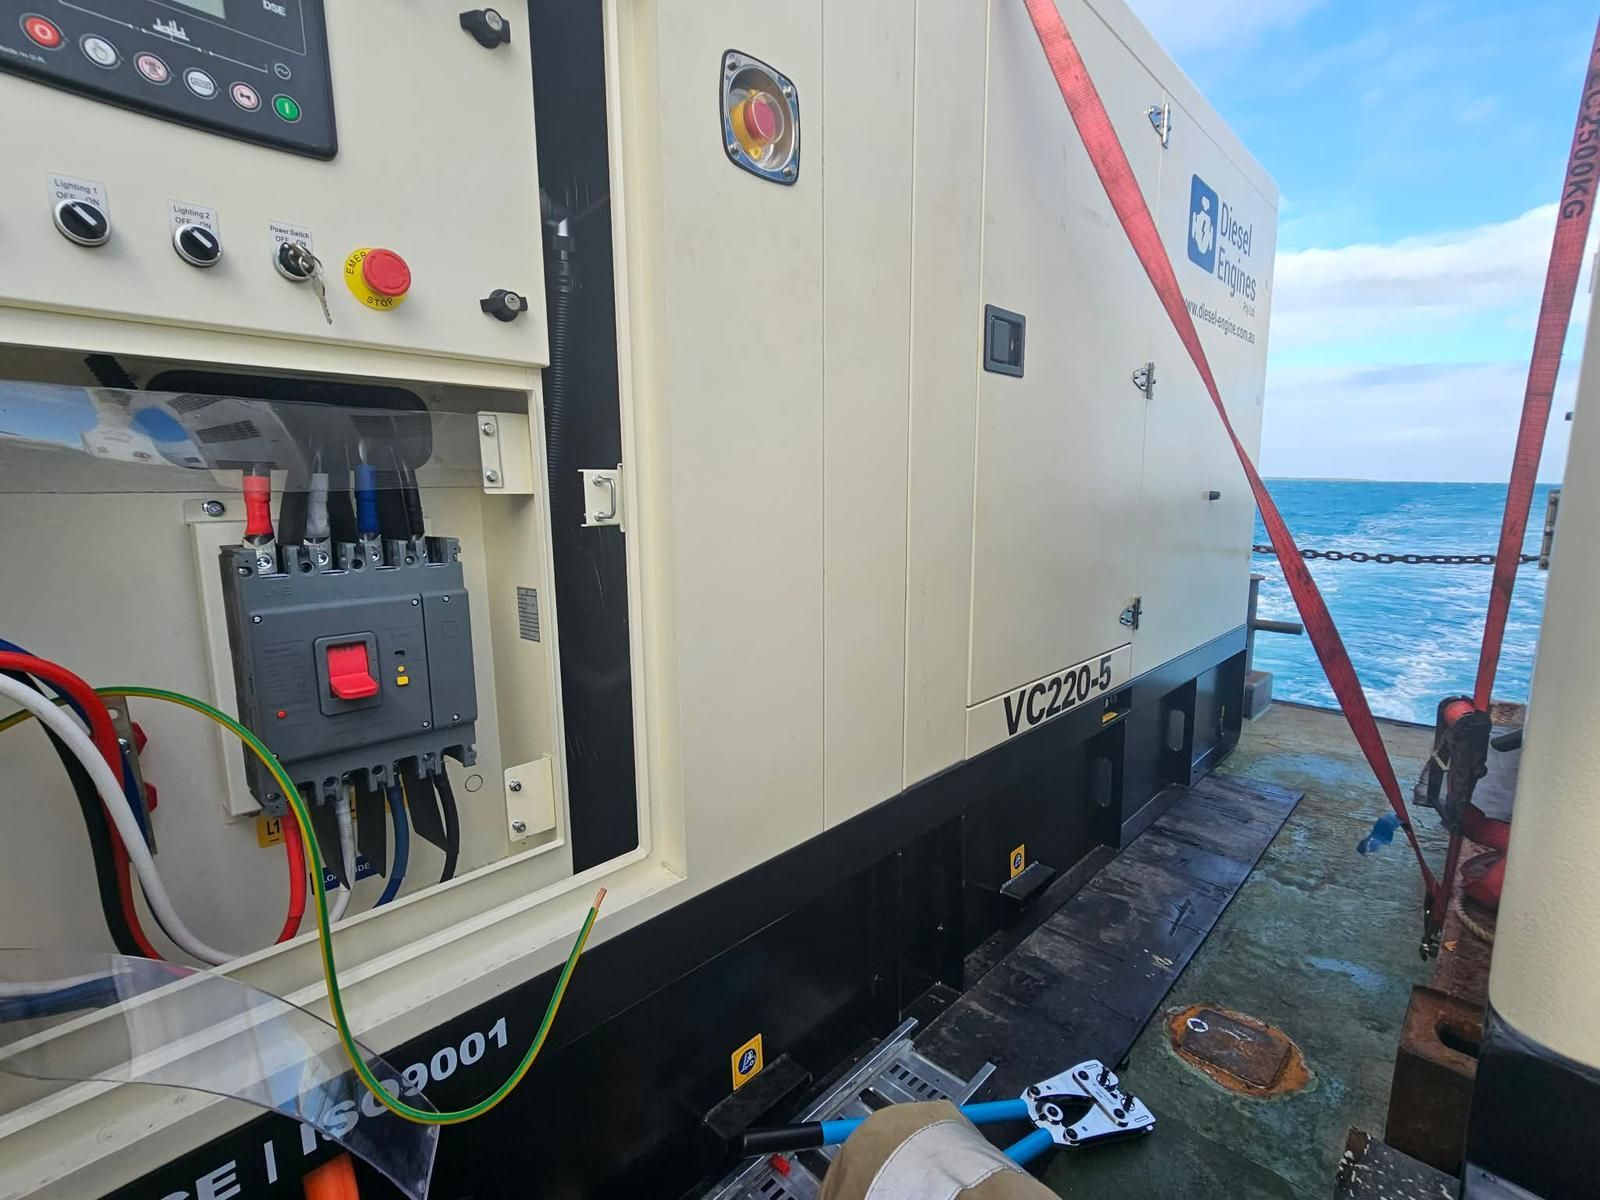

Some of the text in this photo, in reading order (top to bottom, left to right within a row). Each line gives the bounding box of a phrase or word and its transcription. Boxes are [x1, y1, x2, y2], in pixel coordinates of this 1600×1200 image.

[263, 0, 286, 16] DSE
[54, 178, 91, 194] Lighting
[56, 191, 77, 199] OFF
[173, 205, 204, 219] Lighting
[175, 216, 192, 224] OFF
[270, 225, 310, 239] Power Switch
[1220, 201, 1253, 257] Diesel
[296, 239, 307, 247] ON
[346, 251, 366, 275] EMER
[1217, 247, 1256, 301] Engines
[367, 296, 393, 307] STOP
[1003, 654, 1112, 736] VC220-5
[266, 820, 280, 836] L1
[160, 1159, 241, 1200] E
[300, 1017, 509, 1156] ISO9001
